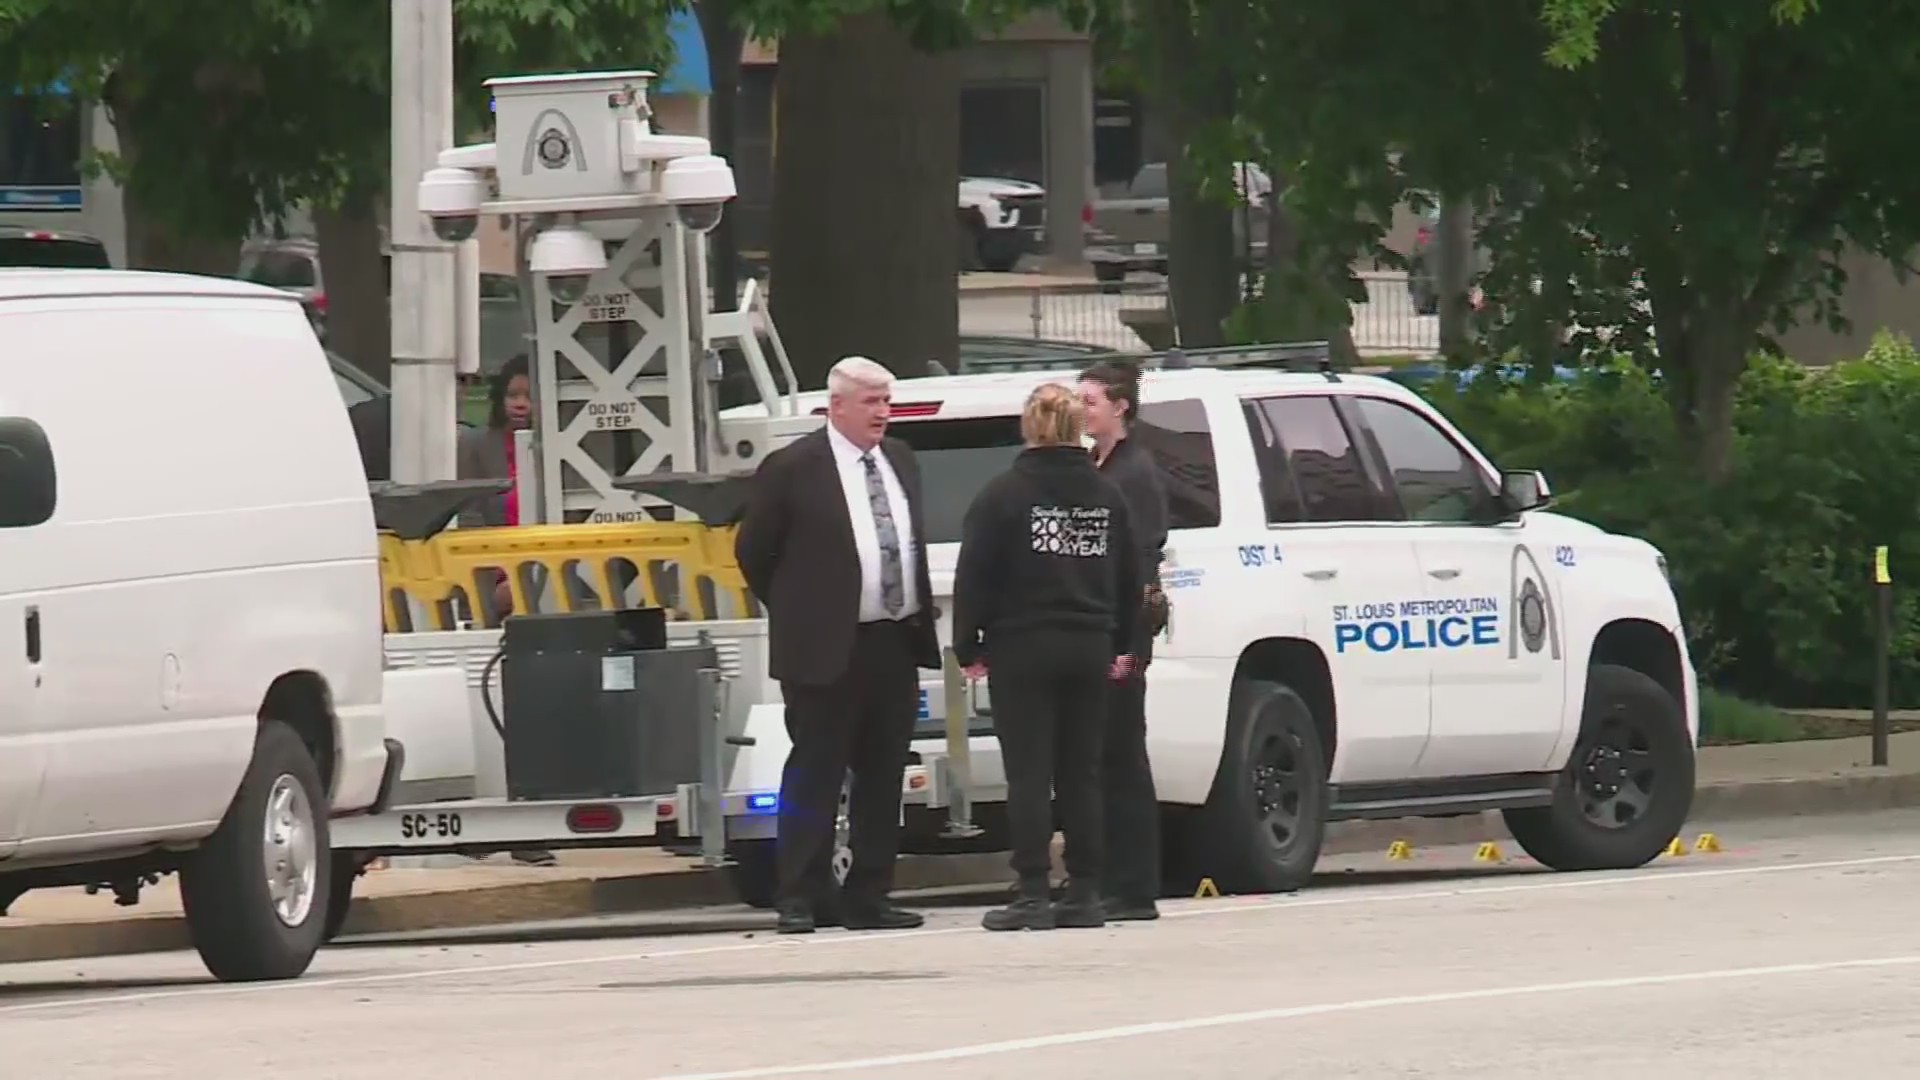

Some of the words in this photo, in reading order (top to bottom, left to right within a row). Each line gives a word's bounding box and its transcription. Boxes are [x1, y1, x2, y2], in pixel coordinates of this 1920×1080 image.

[590, 306, 625, 319] STEP
[588, 403, 607, 415] DO
[610, 402, 636, 414] NOT
[596, 415, 632, 428] STEP
[594, 511, 613, 523] DO
[616, 511, 642, 522] NOT
[1070, 540, 1107, 556] YEAR
[1332, 604, 1353, 621] ST.
[1356, 602, 1395, 619] LOUIS
[1399, 597, 1498, 617] METROPOLITAN
[1335, 615, 1500, 653] POLICE
[401, 813, 462, 838] SC-50
